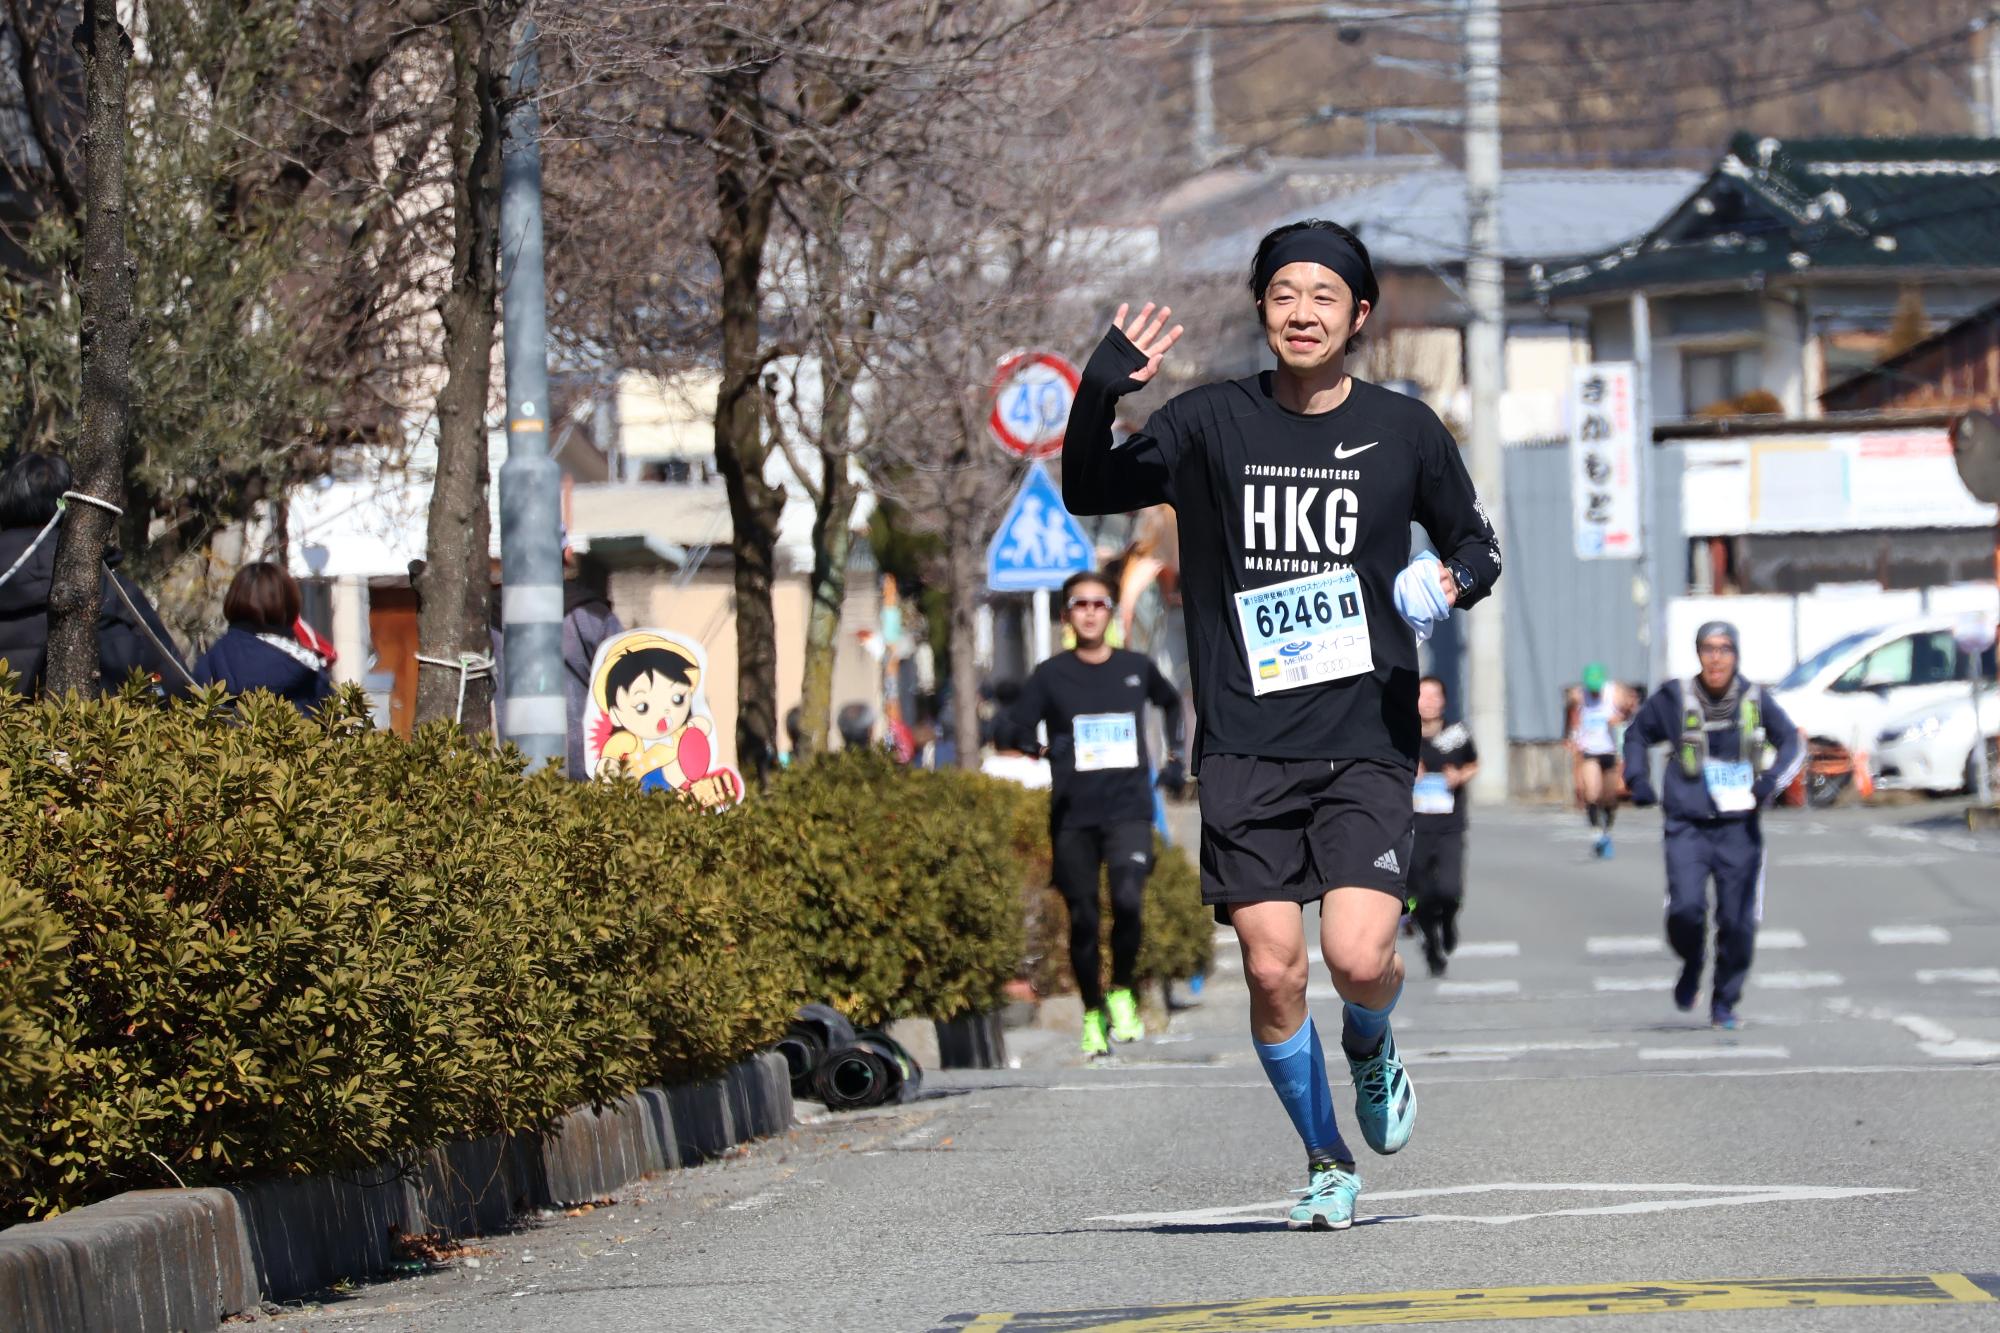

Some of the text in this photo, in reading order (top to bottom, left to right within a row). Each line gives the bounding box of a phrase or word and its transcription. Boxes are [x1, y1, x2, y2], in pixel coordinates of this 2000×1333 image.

[1010, 380, 1066, 429] 40
[1244, 464, 1360, 480] STANDARD CHARTERED
[1244, 484, 1359, 556] HKG
[1245, 556, 1319, 574] MARATHON
[1256, 591, 1333, 638] 6246
[1317, 635, 1366, 653] メイコー
[1283, 653, 1313, 667] MEIKO
